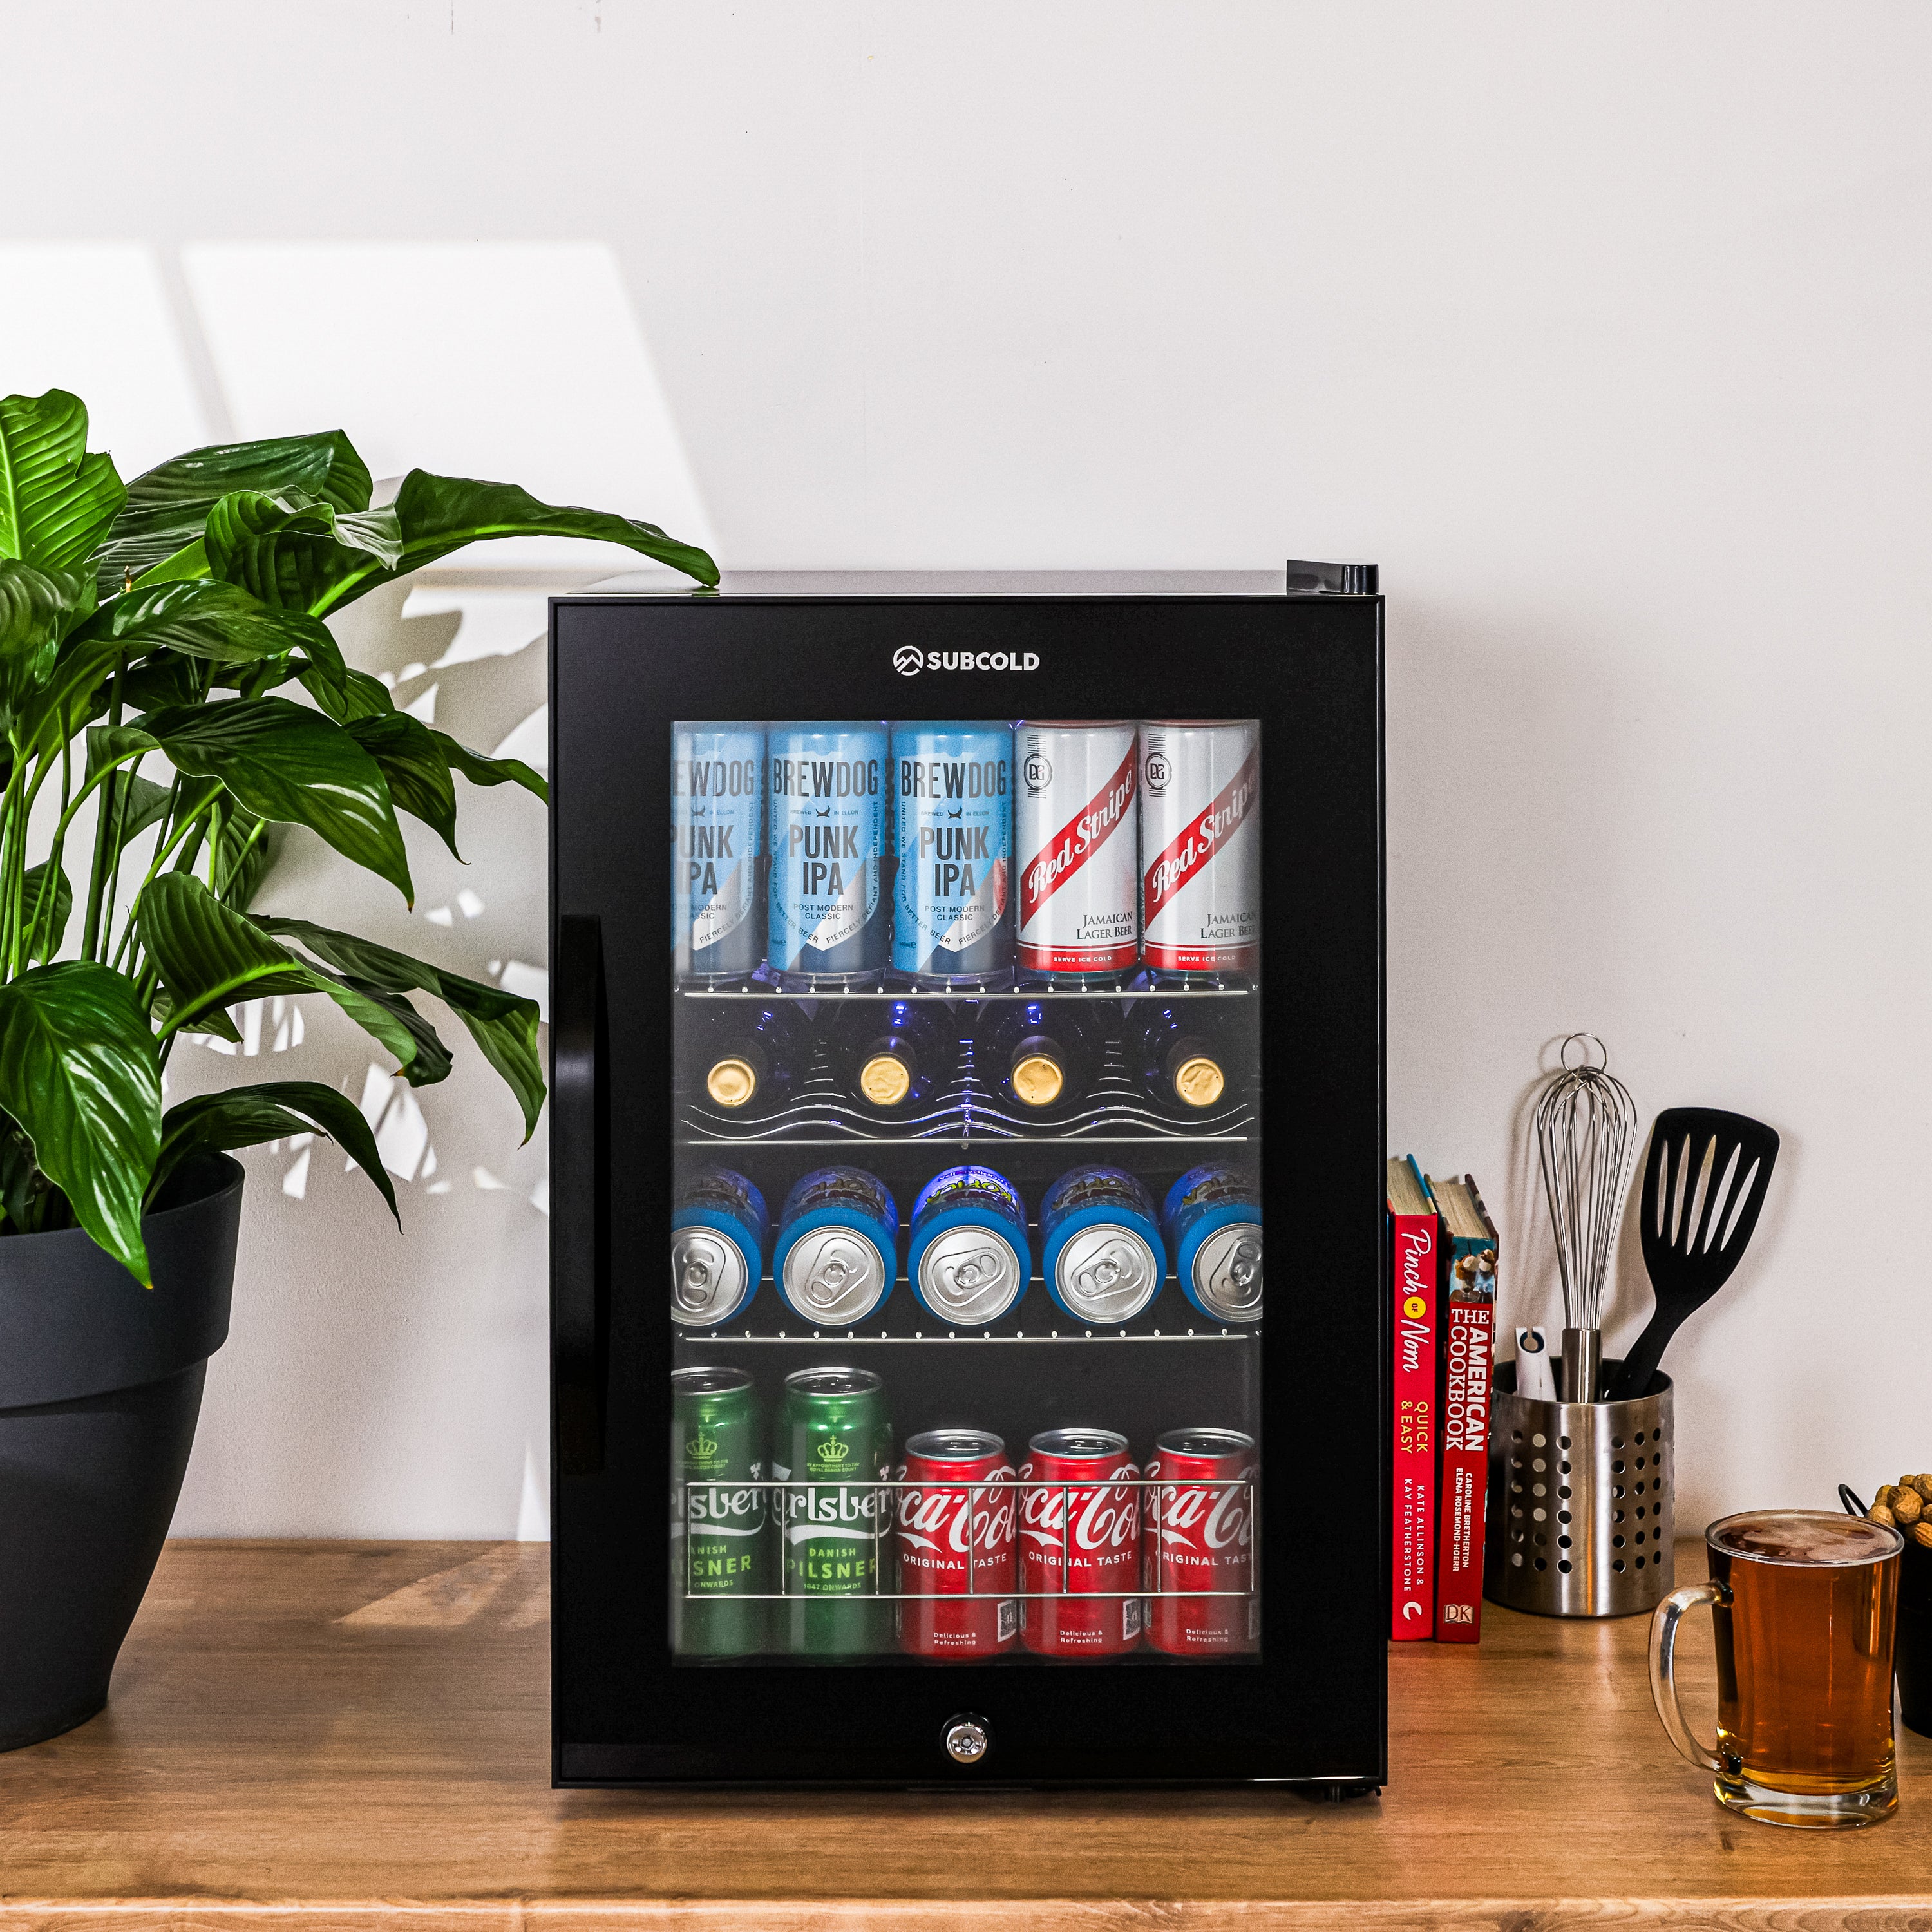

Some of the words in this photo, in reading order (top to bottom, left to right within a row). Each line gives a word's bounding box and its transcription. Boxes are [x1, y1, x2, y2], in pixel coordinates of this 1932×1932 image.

[927, 652, 1040, 670] SUBCOLD
[773, 758, 878, 797] BREWDOG
[902, 759, 1006, 799] BREWDOG
[790, 824, 859, 858] PUNK
[920, 826, 989, 860] PUNK
[1028, 838, 1074, 903] Red
[1074, 770, 1132, 855] Stripe
[803, 862, 844, 895] IPA
[935, 864, 976, 896] IPA
[1152, 837, 1197, 902] Red
[902, 837, 906, 849] WE
[905, 904, 928, 931] BETTER
[930, 929, 951, 945] BEER
[699, 919, 734, 943] FIERCELY
[826, 919, 862, 943] FIERCELY
[862, 887, 878, 920] DEFIANT
[958, 919, 992, 945] FIERCELY
[798, 927, 819, 943] BEER
[1401, 1229, 1432, 1295] Pinch
[1412, 1303, 1418, 1312] OF
[1452, 1309, 1490, 1325] THE
[1401, 1320, 1430, 1373] Nom
[1401, 1400, 1413, 1410] &
[1446, 1325, 1468, 1451] COOKBOOK
[1465, 1327, 1488, 1451] AMERICAN
[1401, 1416, 1413, 1454] EASY
[1414, 1401, 1428, 1452] QUICK
[1455, 1468, 1463, 1493] ELENA
[1464, 1473, 1473, 1513] CAROLINE
[809, 1548, 856, 1557] DANISH
[1097, 1551, 1132, 1566] TASTE
[1462, 1515, 1471, 1568] BRETHERTON
[904, 1553, 965, 1569] ORIGINAL
[1446, 1605, 1471, 1622] DK
